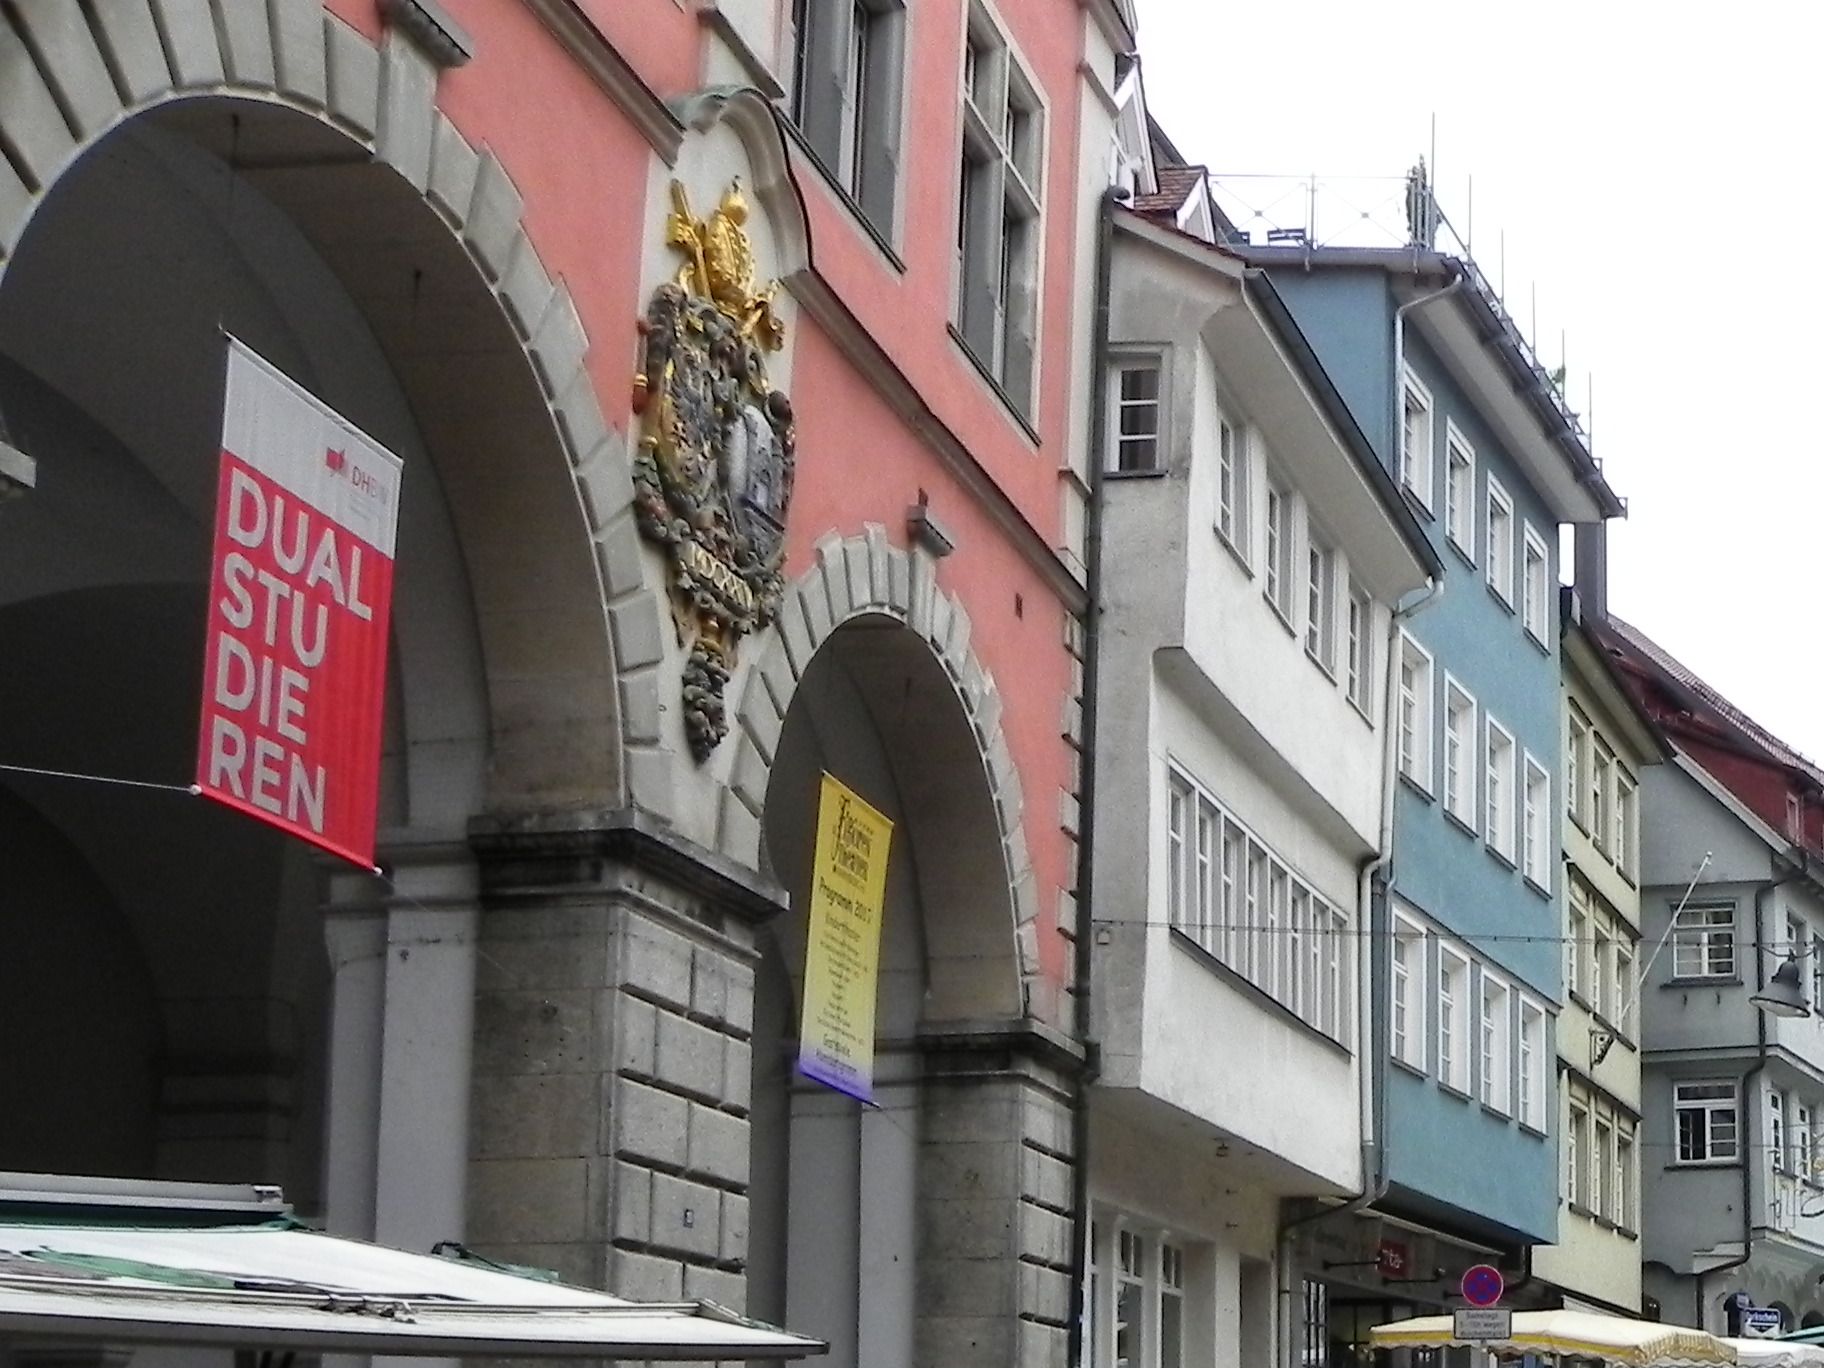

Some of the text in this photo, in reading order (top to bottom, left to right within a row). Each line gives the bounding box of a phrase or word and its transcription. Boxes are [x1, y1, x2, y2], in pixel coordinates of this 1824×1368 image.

[227, 467, 372, 621] DUAL
[219, 552, 328, 668] STU
[214, 632, 310, 745] DIE
[209, 715, 326, 834] REN
